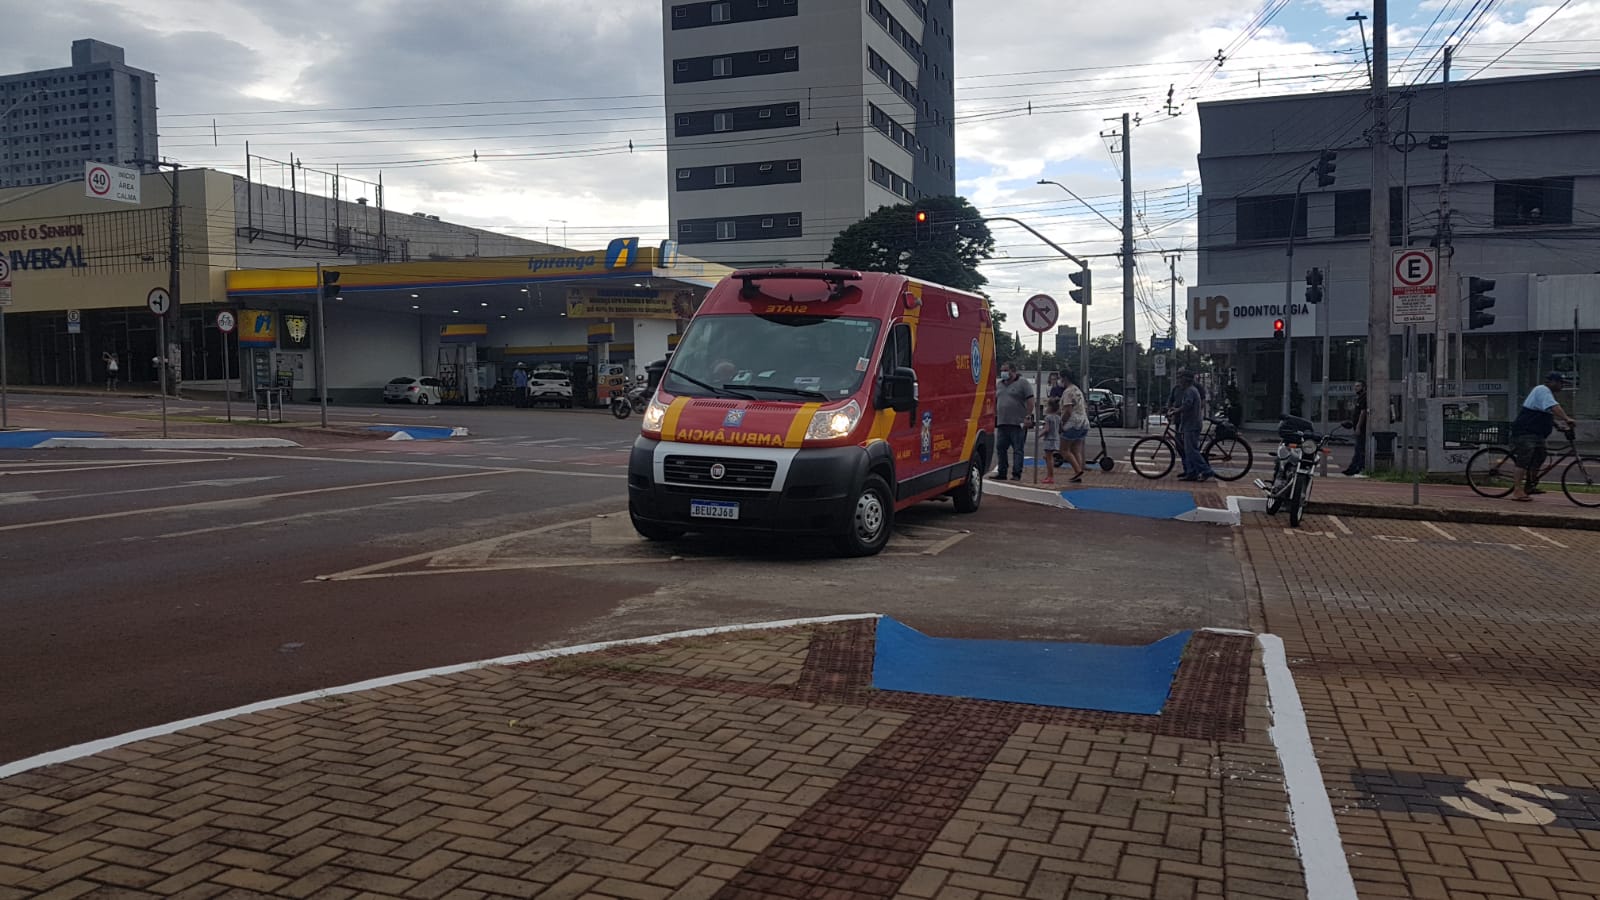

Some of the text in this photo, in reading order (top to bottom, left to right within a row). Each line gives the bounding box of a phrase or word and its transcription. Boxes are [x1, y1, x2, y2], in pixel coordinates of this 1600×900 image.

[93, 173, 106, 186] 40
[0, 245, 87, 271] IVERSAL
[1408, 259, 1421, 278] E
[1193, 295, 1230, 330] HG
[955, 354, 970, 370] SIATE
